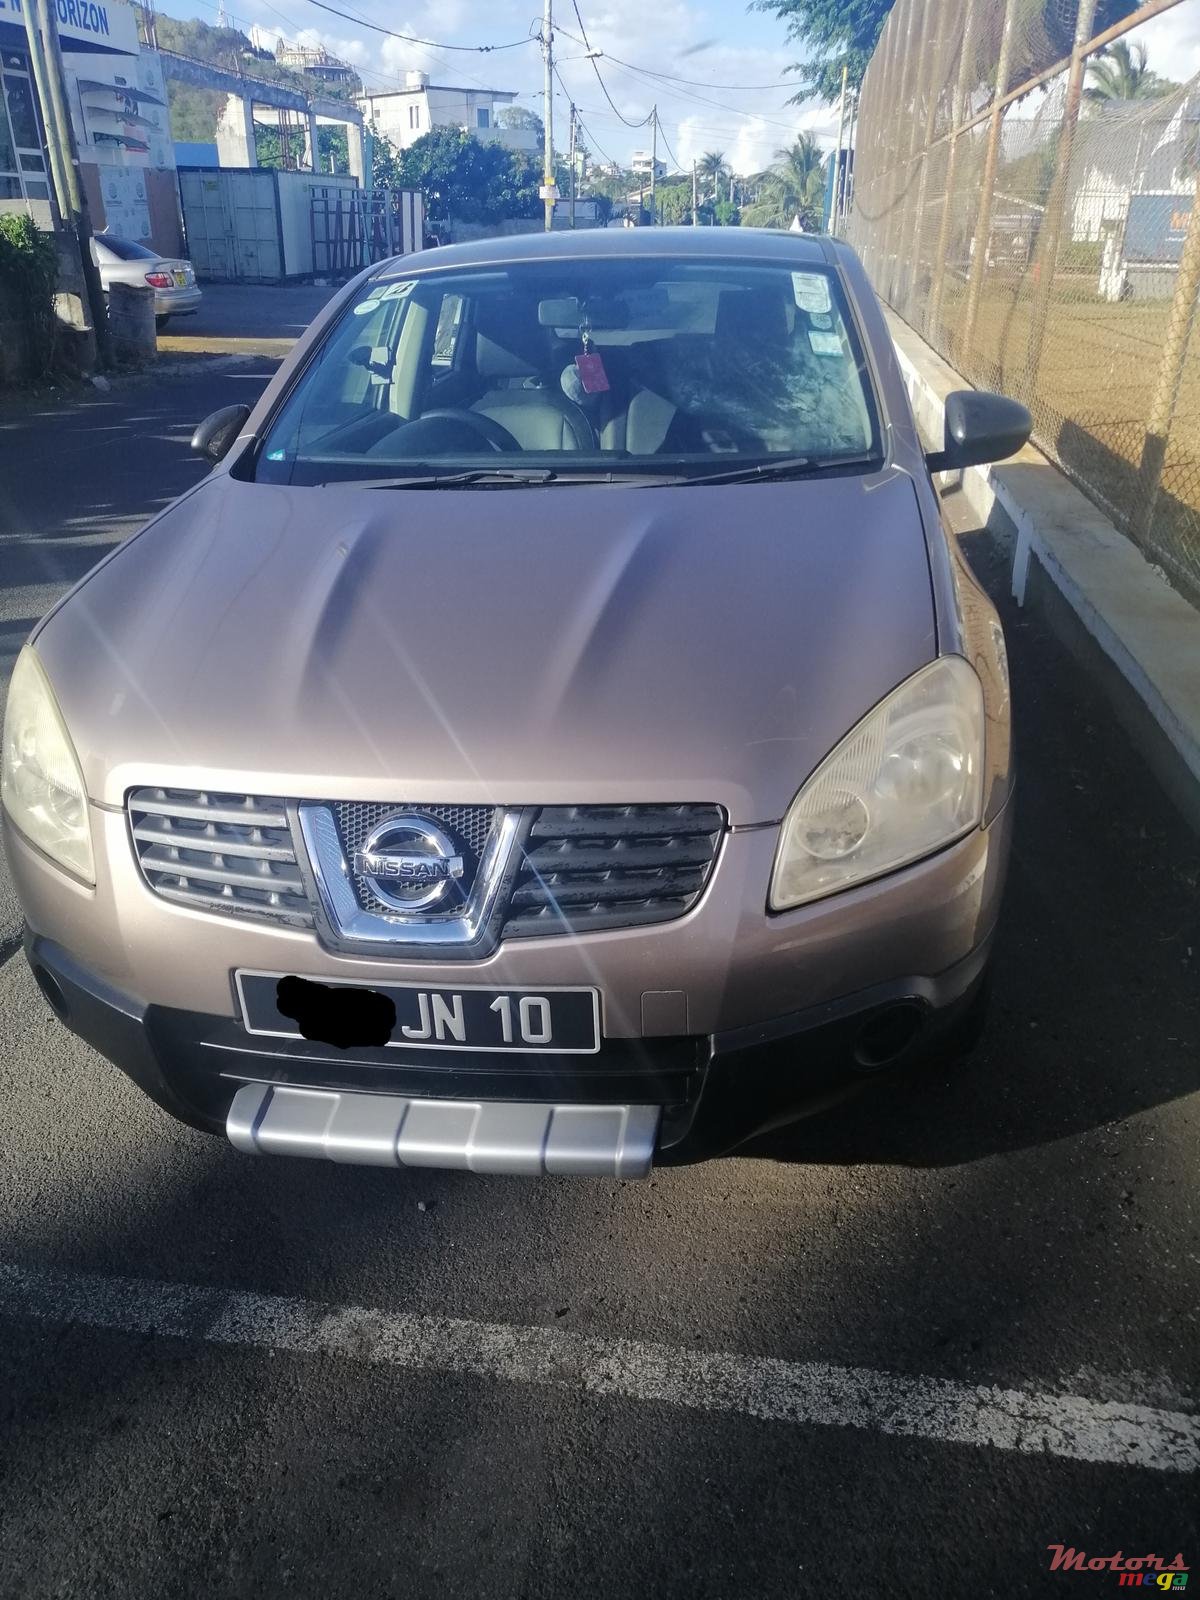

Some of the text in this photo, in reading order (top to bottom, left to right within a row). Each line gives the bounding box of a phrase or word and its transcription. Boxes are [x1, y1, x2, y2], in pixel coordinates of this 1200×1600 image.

[55, 0, 109, 36] ORIZON
[363, 859, 450, 877] NISSAN
[402, 993, 551, 1044] JN 10
